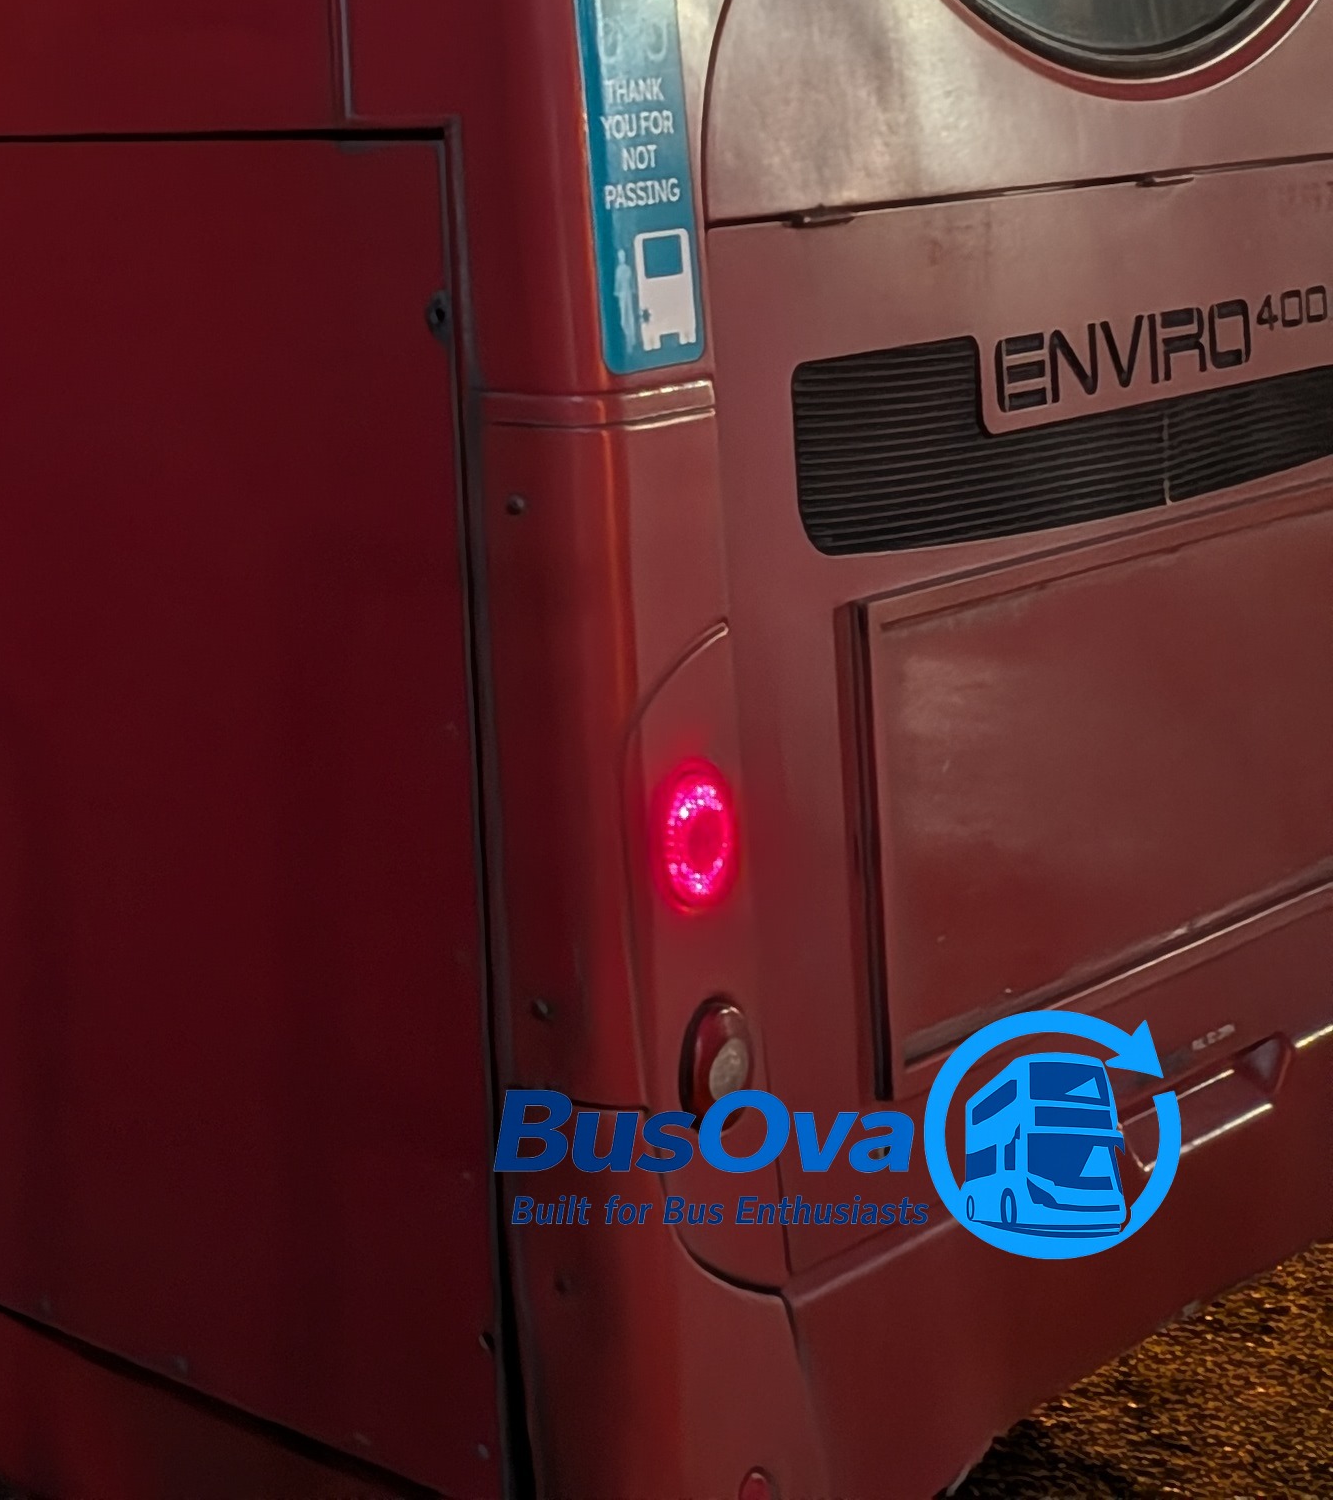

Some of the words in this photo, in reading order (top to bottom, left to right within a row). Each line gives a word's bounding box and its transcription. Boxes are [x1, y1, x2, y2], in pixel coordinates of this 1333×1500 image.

[603, 77, 665, 106] THANK
[600, 113, 637, 140] YOU
[640, 109, 675, 136] FOR
[622, 144, 658, 172] NOT
[604, 177, 681, 210] PASSING
[994, 299, 1251, 413] ENVIRO
[1256, 284, 1328, 331] 400
